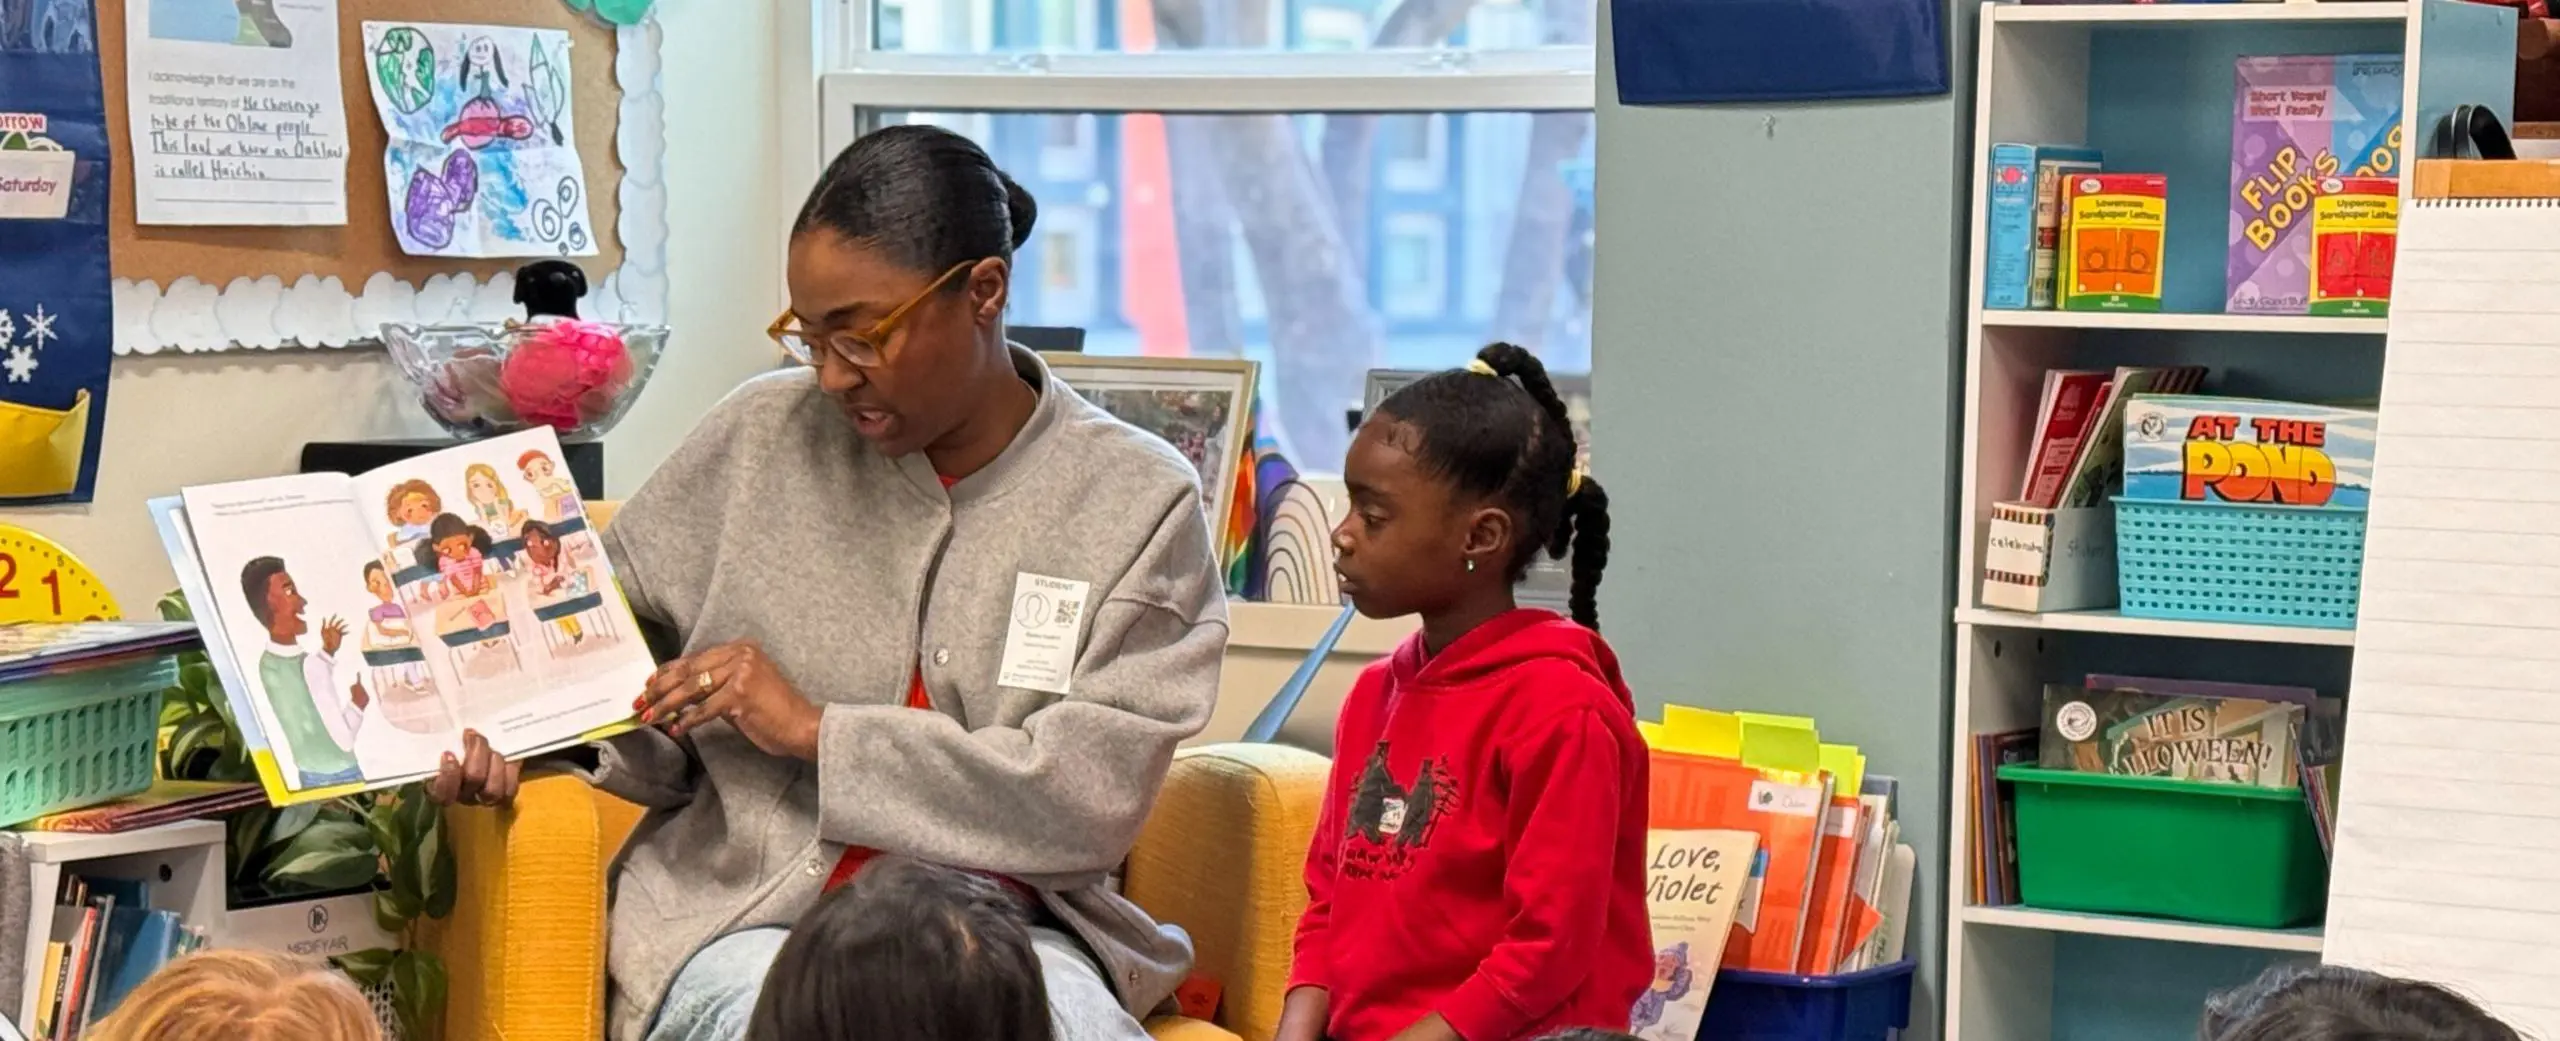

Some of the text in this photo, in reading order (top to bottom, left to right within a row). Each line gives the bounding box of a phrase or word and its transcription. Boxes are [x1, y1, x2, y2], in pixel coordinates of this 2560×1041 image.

[153, 72, 215, 88] acknowledge
[217, 74, 234, 87] that
[237, 78, 249, 87] we
[251, 78, 266, 88] are
[281, 78, 295, 89] the
[2250, 90, 2327, 102] Short Vowel
[2250, 104, 2324, 118] Word Family
[2240, 146, 2297, 213] FLIP
[2096, 200, 2145, 209] Lowercase
[2244, 148, 2340, 251] BOOKS
[2337, 200, 2387, 210] Uppercase
[2079, 209, 2160, 221] Sandpaper Letters
[2320, 210, 2398, 221] Sandpaper Letter
[2187, 415, 2241, 441] AT
[2251, 417, 2327, 448] THE
[2181, 441, 2337, 506] POND
[1034, 578, 1075, 592] STUDENT
[2143, 706, 2207, 741] IT IS
[2109, 738, 2274, 777] LLOWEEN!
[1649, 842, 1721, 873] Love,
